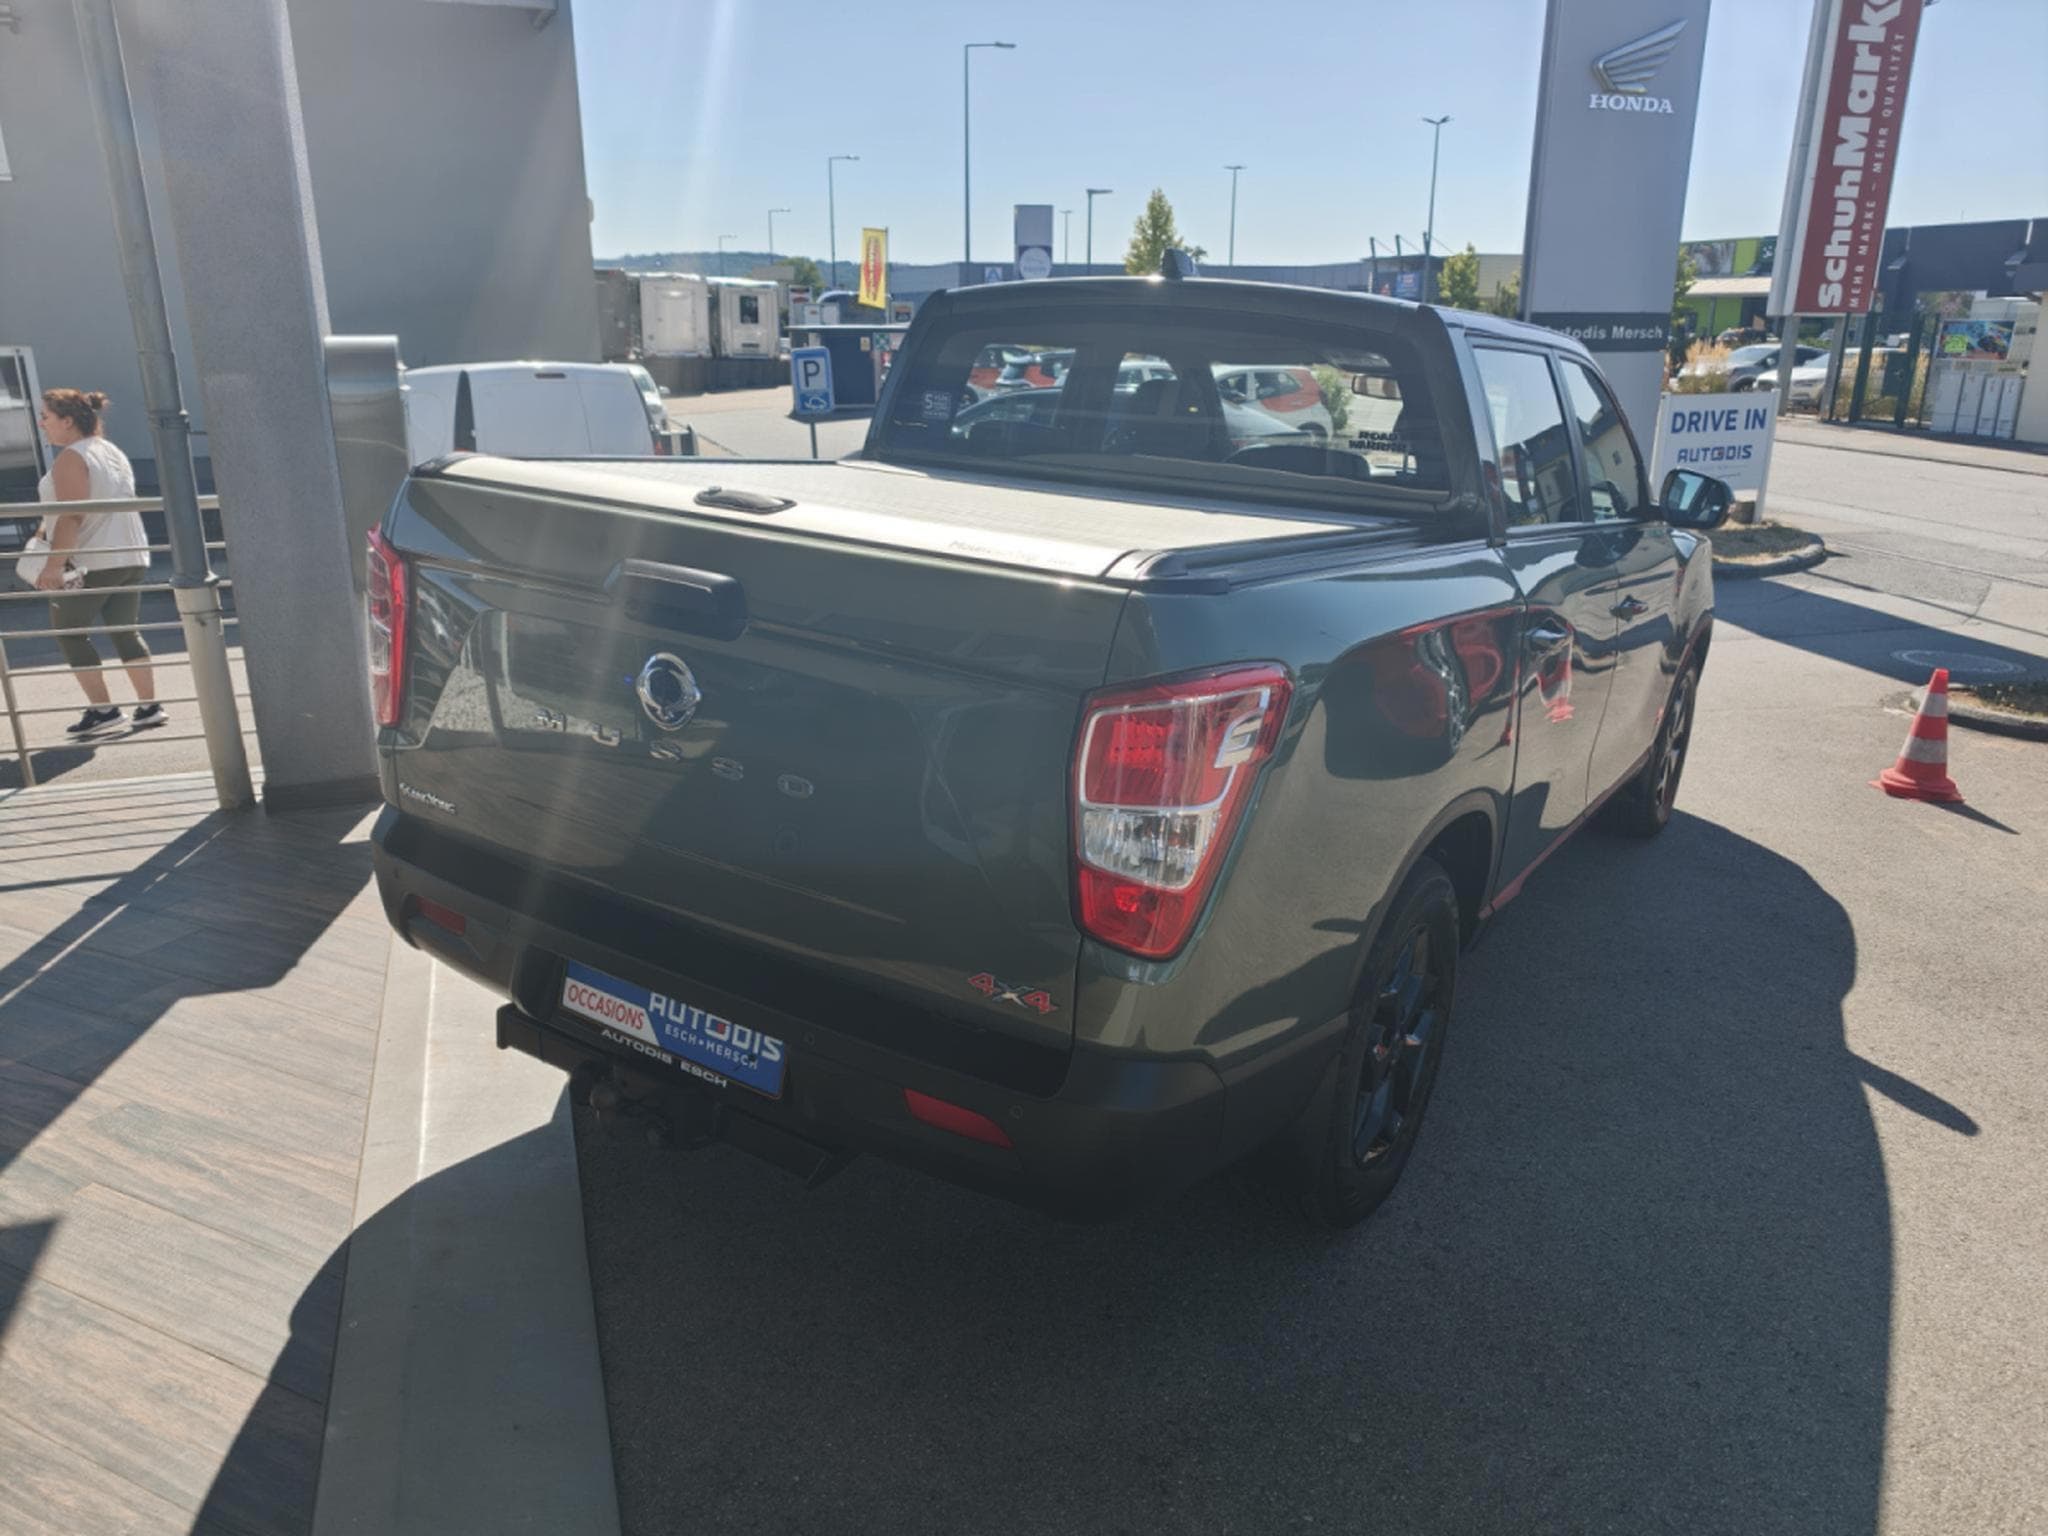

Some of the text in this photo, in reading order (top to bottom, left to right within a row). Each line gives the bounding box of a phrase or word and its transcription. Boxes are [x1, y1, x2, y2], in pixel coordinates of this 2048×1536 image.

[1588, 93, 1674, 114] HONDA
[1817, 0, 1903, 308] SchuhMark
[1848, 264, 1865, 308] MEHR
[1857, 200, 1877, 256] MARKE
[1872, 127, 1890, 174] MEHR
[1611, 325, 1663, 340] Mersch
[803, 359, 821, 389] P
[1670, 408, 1768, 434] DRIVE IN
[1676, 444, 1753, 463] AUTODIS
[567, 984, 645, 1031] OCCASIONS
[649, 991, 784, 1063] AUTODIS
[601, 1028, 728, 1088] AUTODIS ESCH
